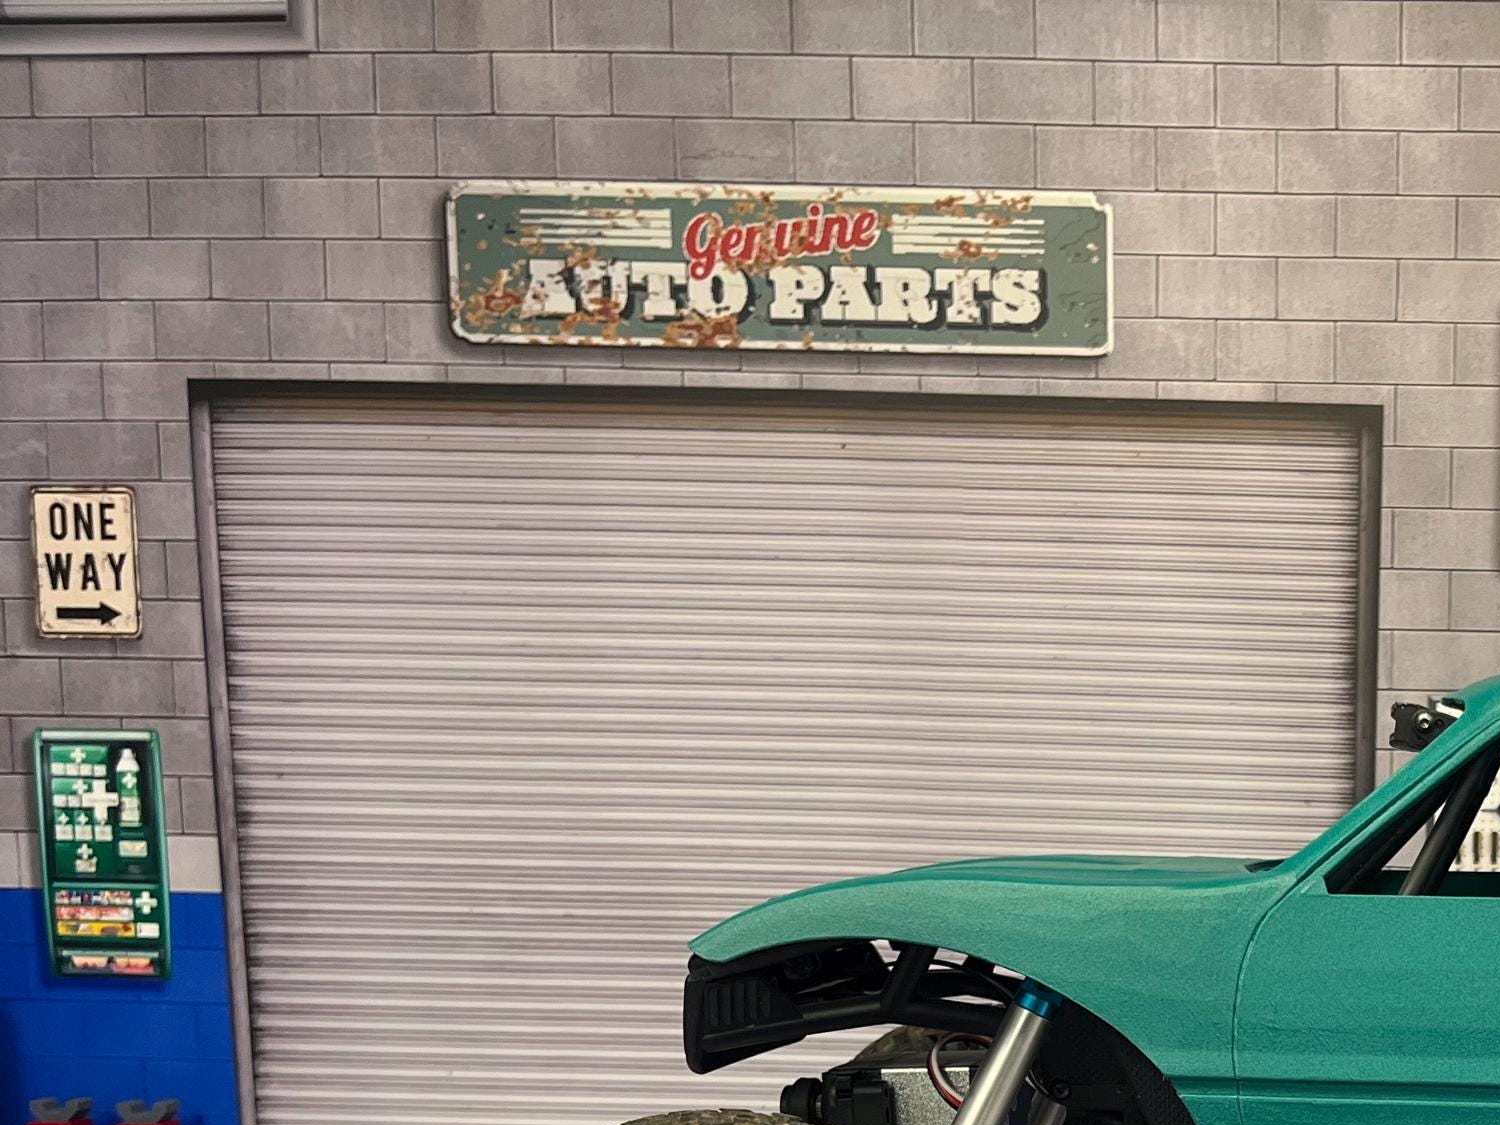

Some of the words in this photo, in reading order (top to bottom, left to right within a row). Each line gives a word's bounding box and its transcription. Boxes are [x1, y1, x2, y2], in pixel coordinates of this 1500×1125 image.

[683, 203, 879, 279] Genuine
[524, 260, 746, 320] AUTO
[769, 266, 1043, 324] PARTS
[49, 502, 118, 541] ONE
[44, 553, 127, 592] WAY
